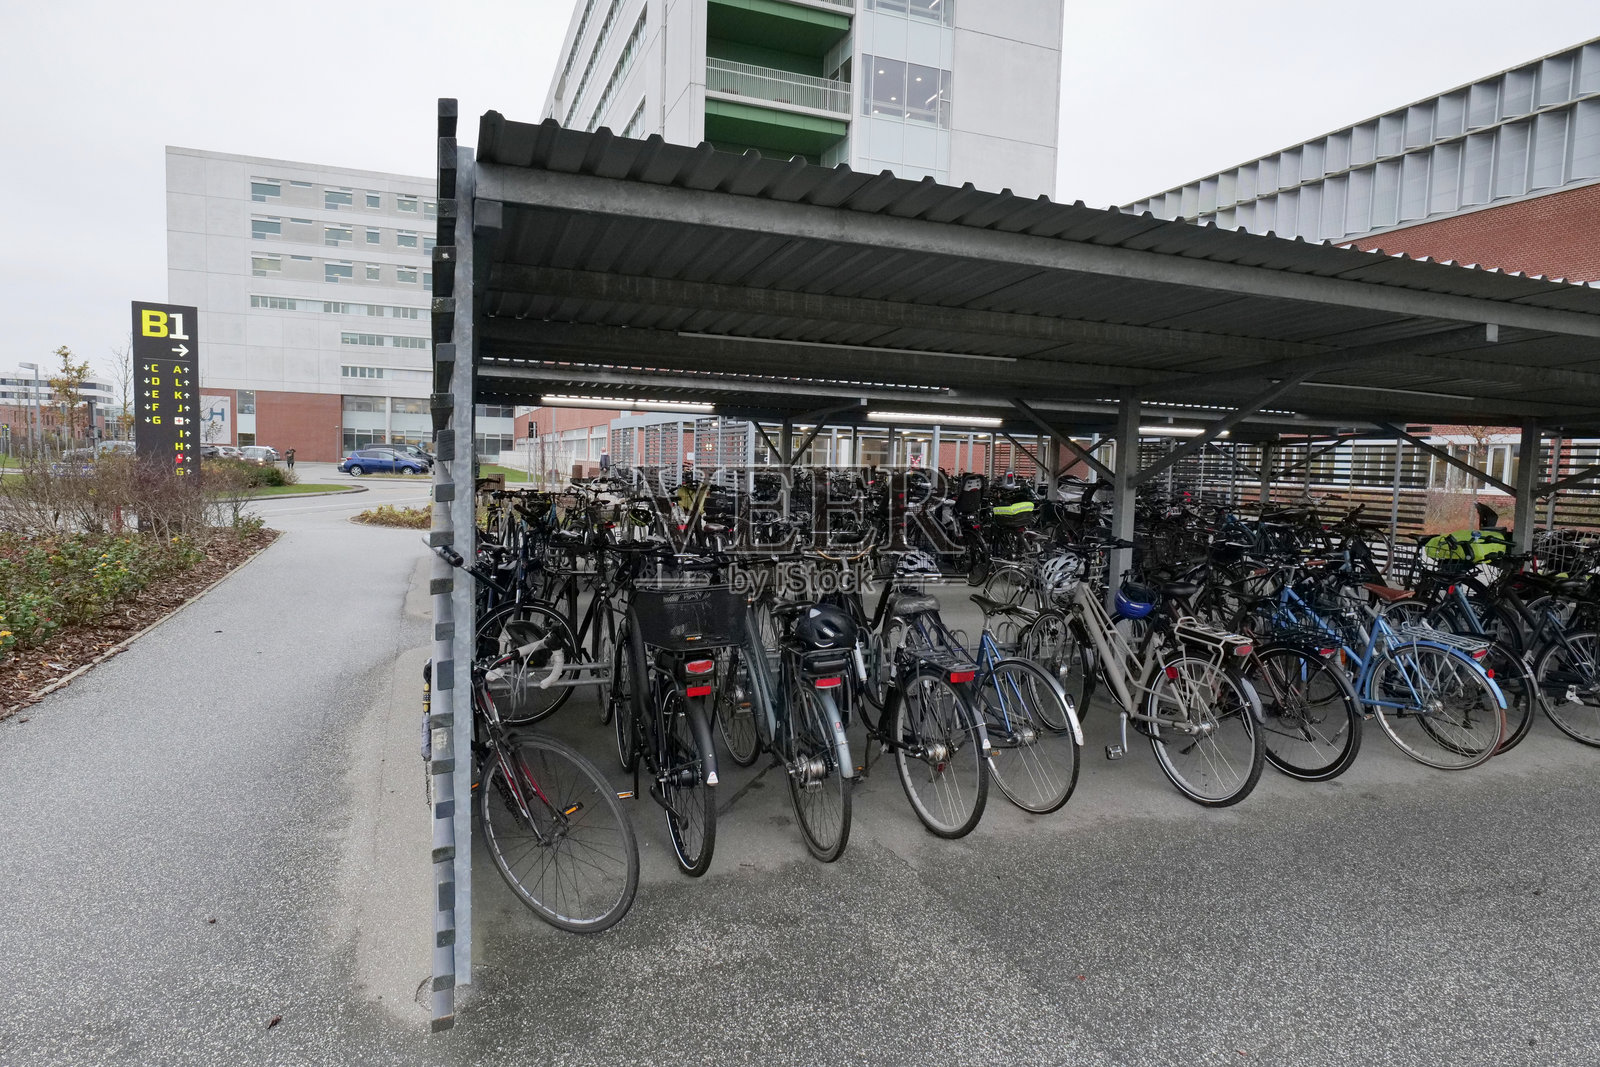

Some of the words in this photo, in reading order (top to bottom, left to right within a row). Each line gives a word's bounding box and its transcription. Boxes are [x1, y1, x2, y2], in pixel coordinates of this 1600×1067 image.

[142, 309, 189, 340] B1
[151, 364, 159, 373] C
[173, 366, 182, 374] A
[152, 377, 160, 386] D
[175, 379, 182, 387] L
[152, 390, 160, 399] E
[174, 391, 182, 400] K
[152, 403, 160, 411] F
[177, 404, 183, 413] J
[153, 416, 161, 425] G
[175, 442, 184, 451] H
